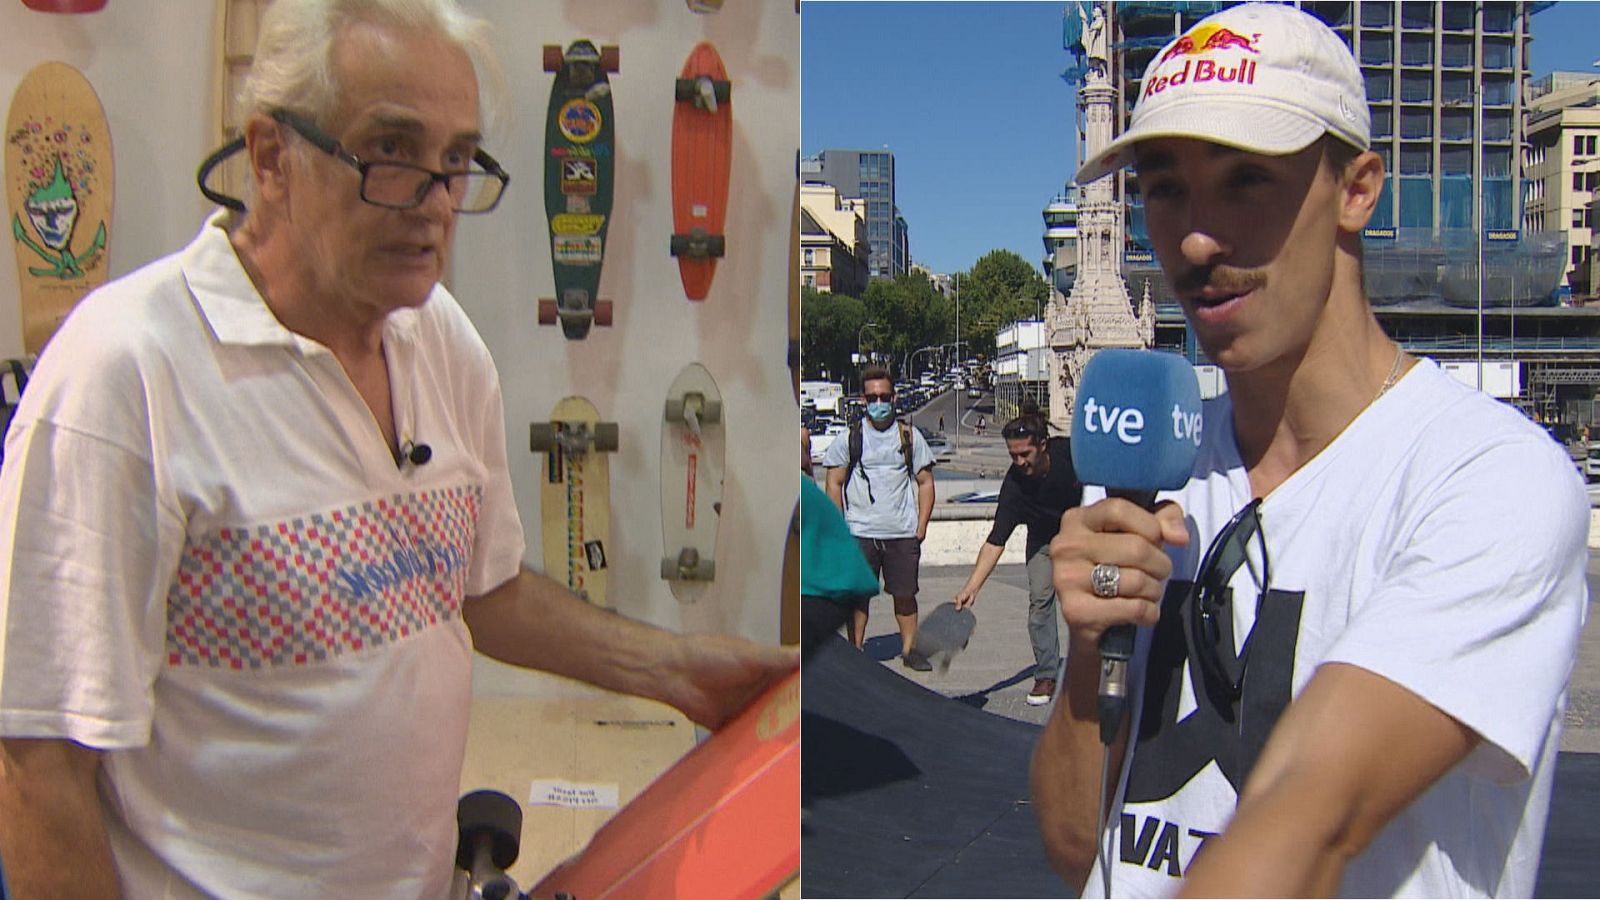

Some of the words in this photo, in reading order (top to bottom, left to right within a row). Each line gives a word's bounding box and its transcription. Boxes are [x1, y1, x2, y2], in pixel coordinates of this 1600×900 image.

[1143, 60, 1191, 102] Red
[1193, 58, 1257, 86] Bull
[1488, 231, 1517, 240] DRAGADOS
[1083, 396, 1145, 445] tve
[1171, 403, 1203, 447] tve
